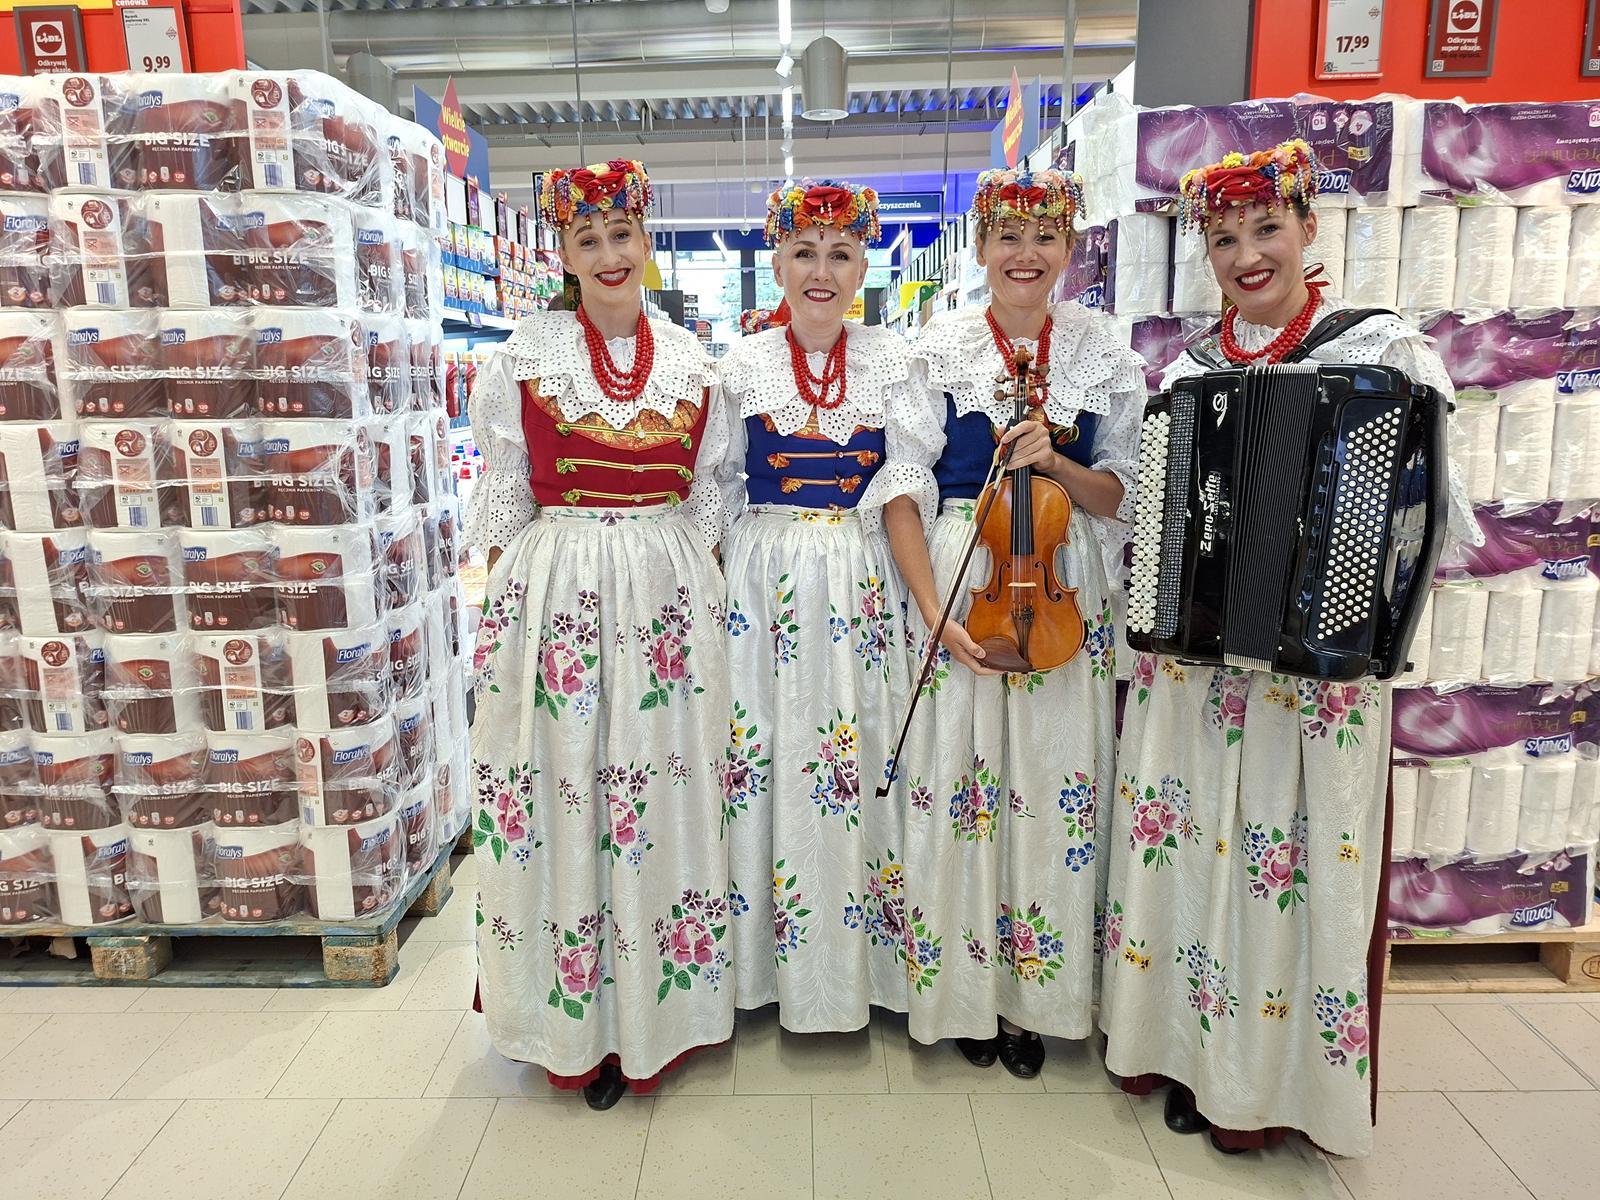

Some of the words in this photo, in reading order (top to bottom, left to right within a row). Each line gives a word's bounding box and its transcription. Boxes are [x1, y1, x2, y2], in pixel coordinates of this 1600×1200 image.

[1336, 35, 1370, 53] 17.99
[1447, 36, 1478, 45] Odkrywaj
[1460, 43, 1482, 52] okazje.
[38, 60, 68, 68] Odkrywaj
[142, 56, 171, 73] 9.99
[442, 104, 466, 133] Wielkie
[1355, 121, 1363, 132] 4
[173, 131, 211, 147] SIZE
[442, 134, 470, 157] otwarcie
[5, 216, 48, 231] Floralys
[248, 250, 269, 265] BIG
[273, 250, 310, 265] SIZE
[0, 367, 25, 381] IZE
[194, 365, 232, 379] SIZE
[290, 365, 329, 378] SIZE
[1557, 368, 1600, 390] oralys
[298, 475, 334, 487] SIZE
[215, 581, 251, 593] SIZE
[288, 582, 318, 594] SIZE
[391, 659, 404, 671] IG
[209, 750, 238, 764] Floralys
[246, 778, 281, 792] SIZE
[251, 873, 285, 888] SIZE
